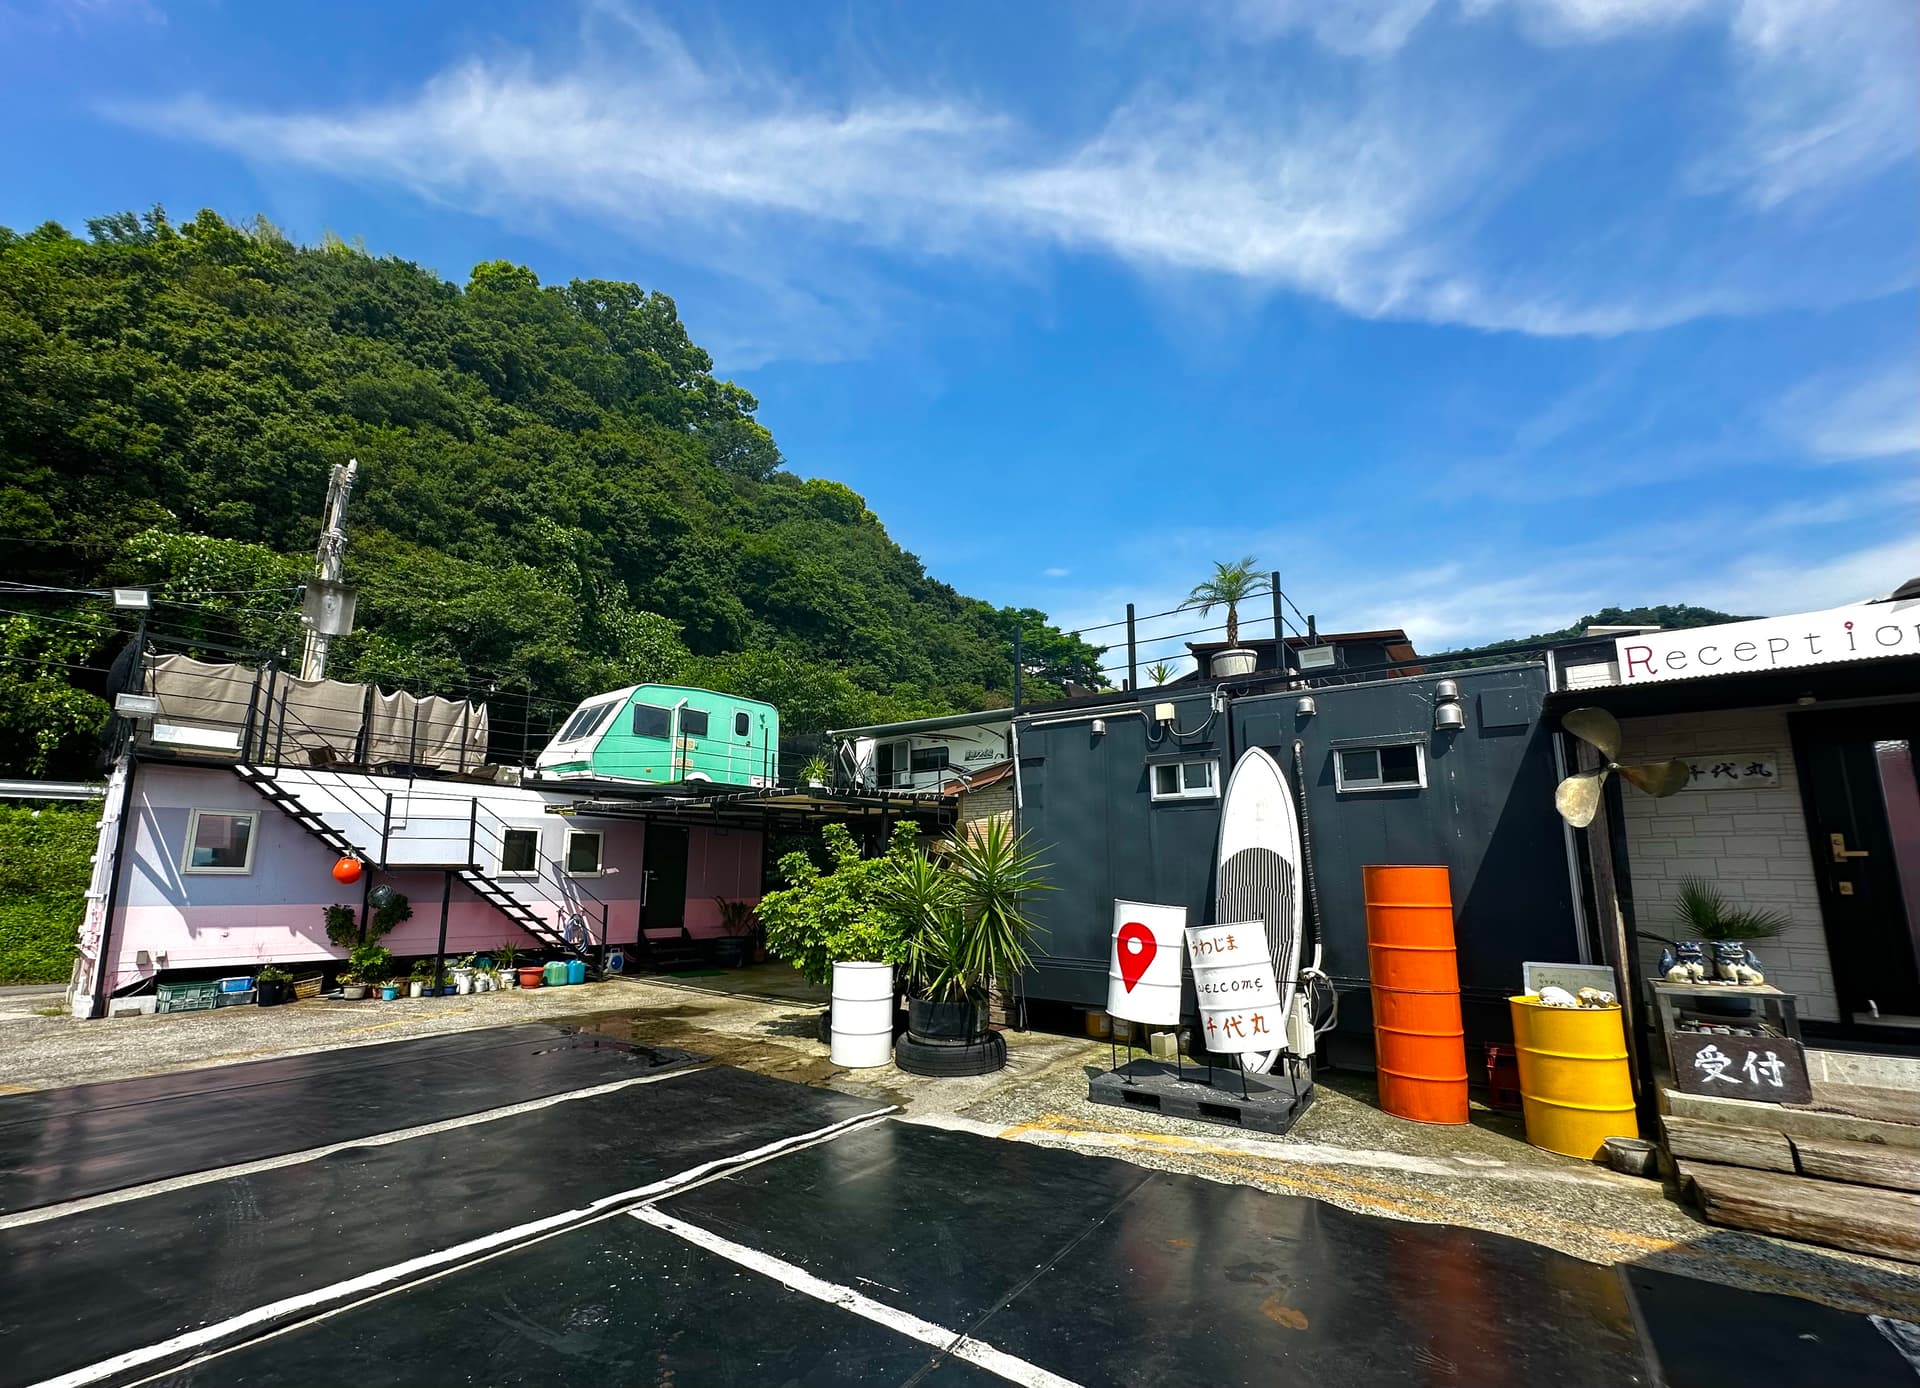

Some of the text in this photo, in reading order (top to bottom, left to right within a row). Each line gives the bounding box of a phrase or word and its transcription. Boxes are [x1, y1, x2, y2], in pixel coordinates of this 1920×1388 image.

[1624, 621, 1920, 678] Receptio
[1206, 1012, 1270, 1040] 千代丸
[1694, 1044, 1785, 1088] 受付
